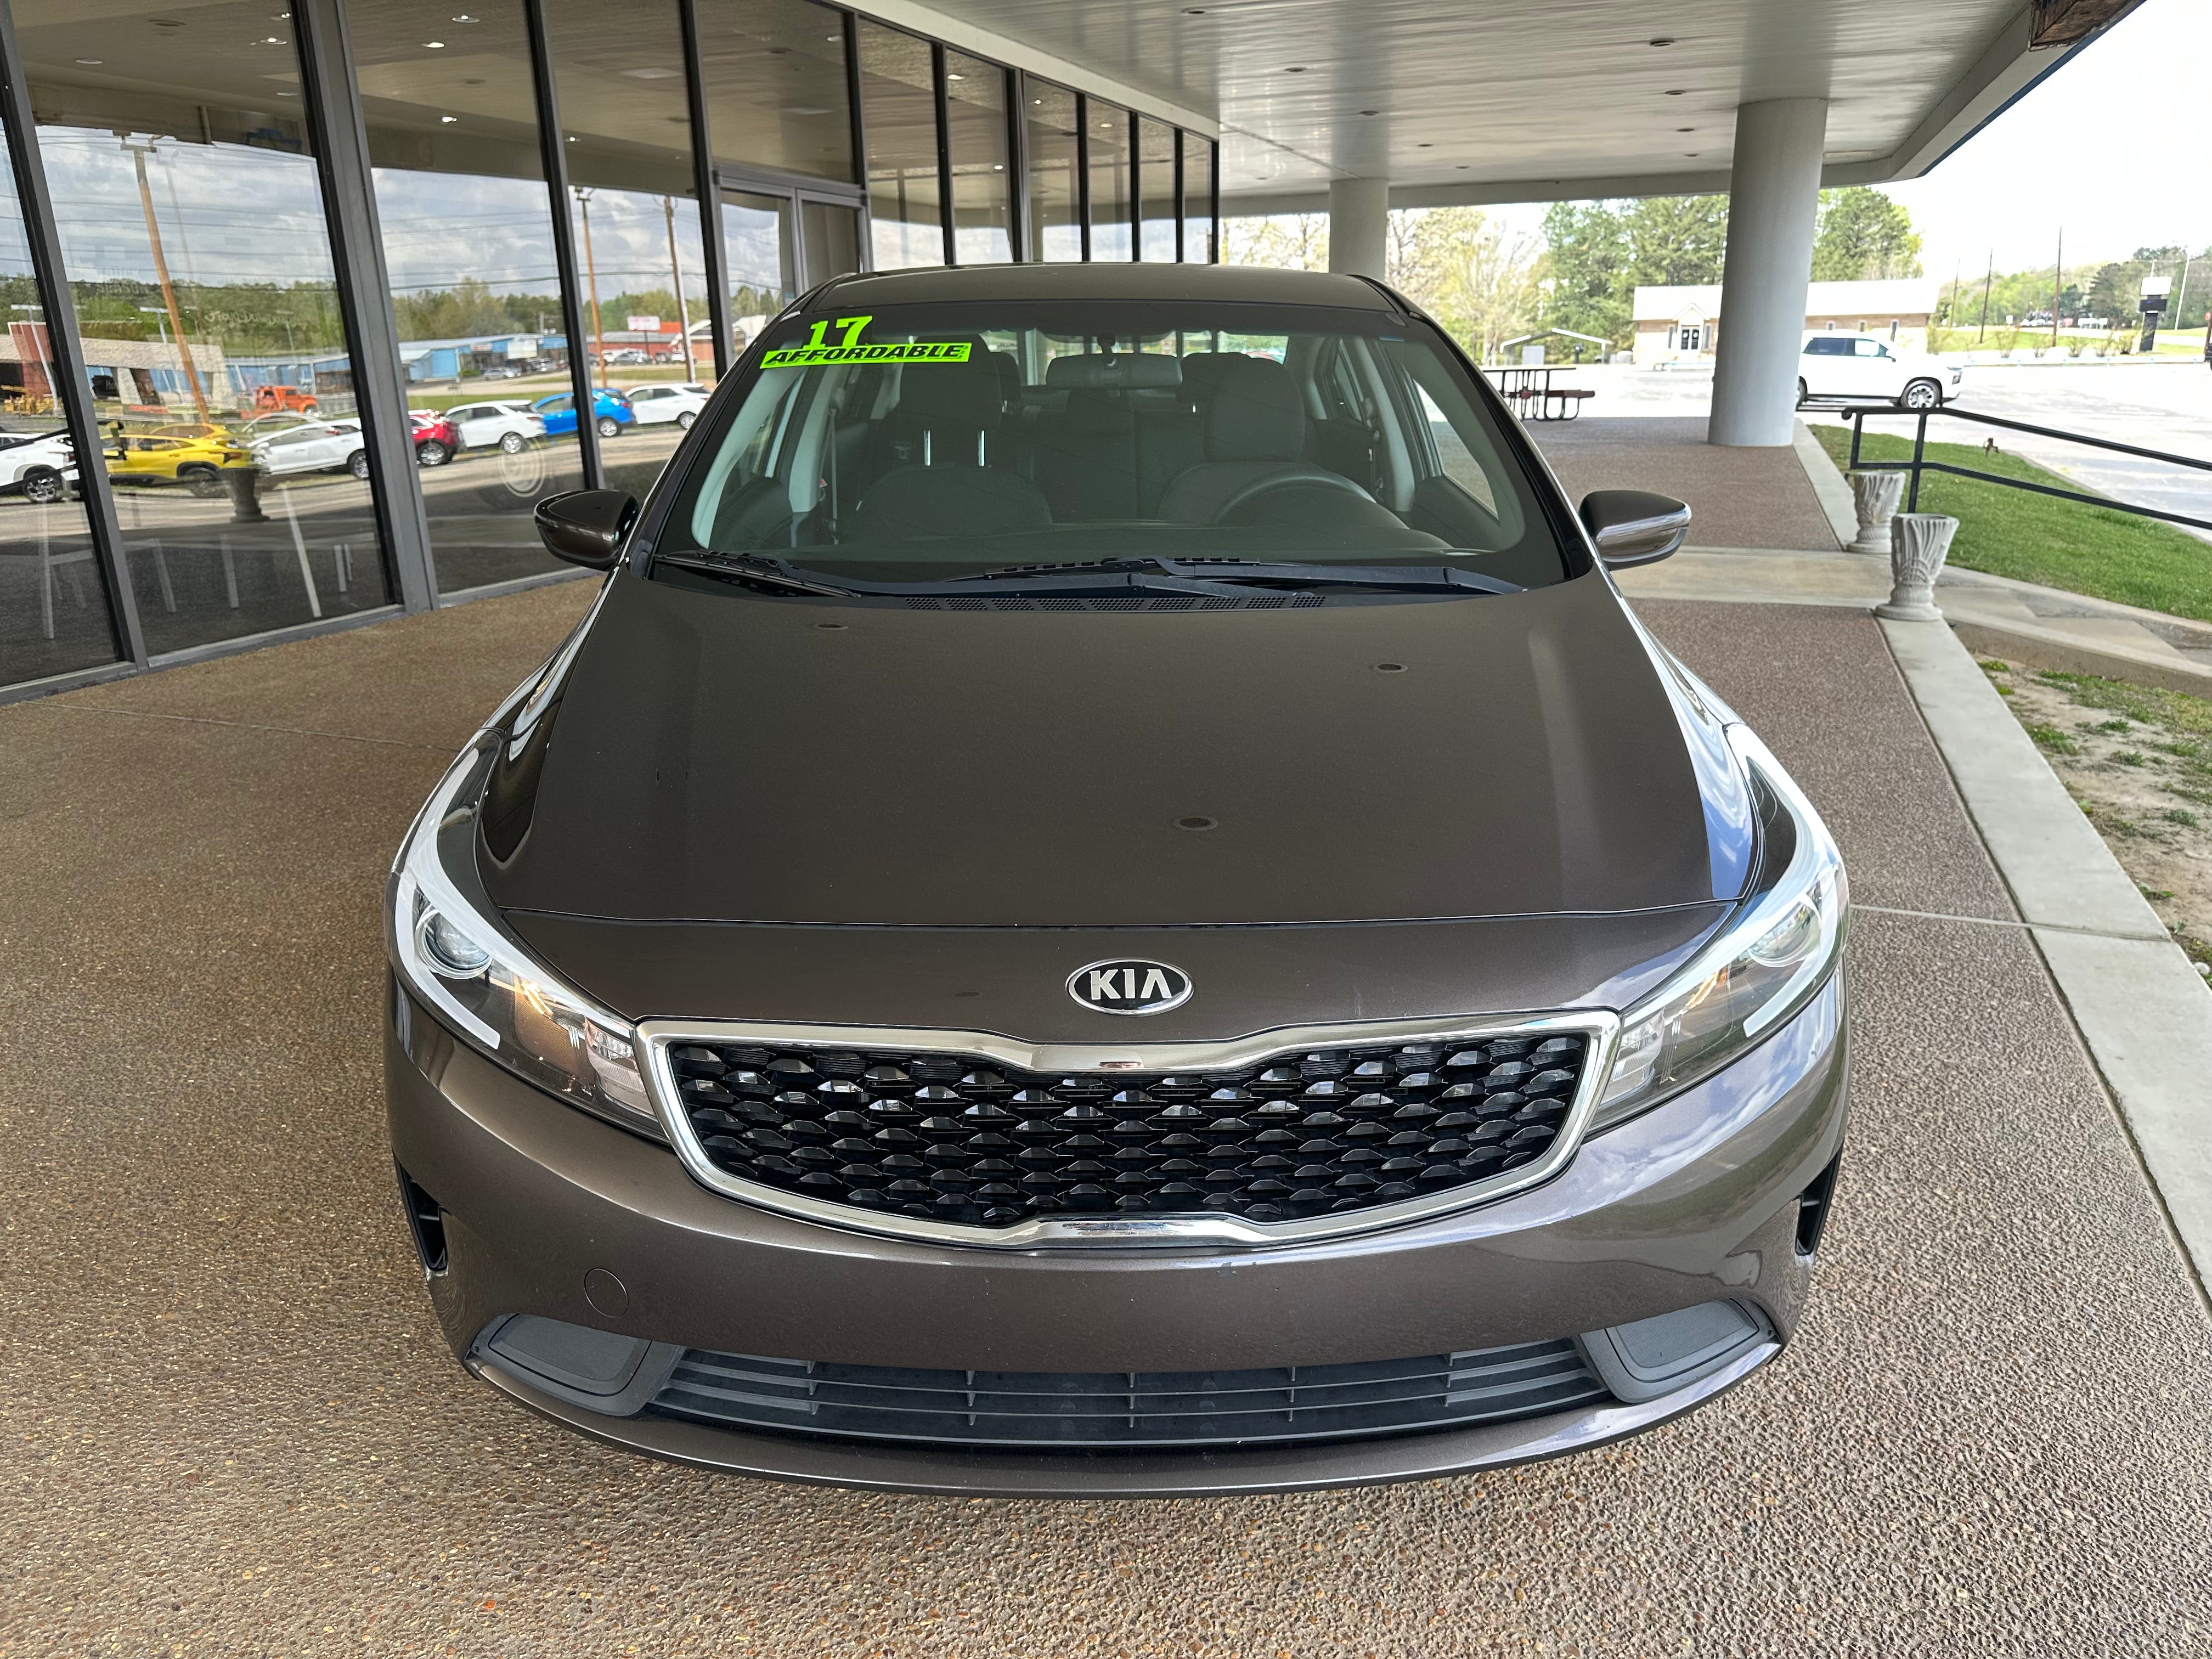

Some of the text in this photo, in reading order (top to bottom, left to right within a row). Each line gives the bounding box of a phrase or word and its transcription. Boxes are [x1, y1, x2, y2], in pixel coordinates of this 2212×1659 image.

[803, 315, 873, 349] 17
[765, 345, 965, 364] AFFORDABLE
[1089, 968, 1172, 1000] KIA
